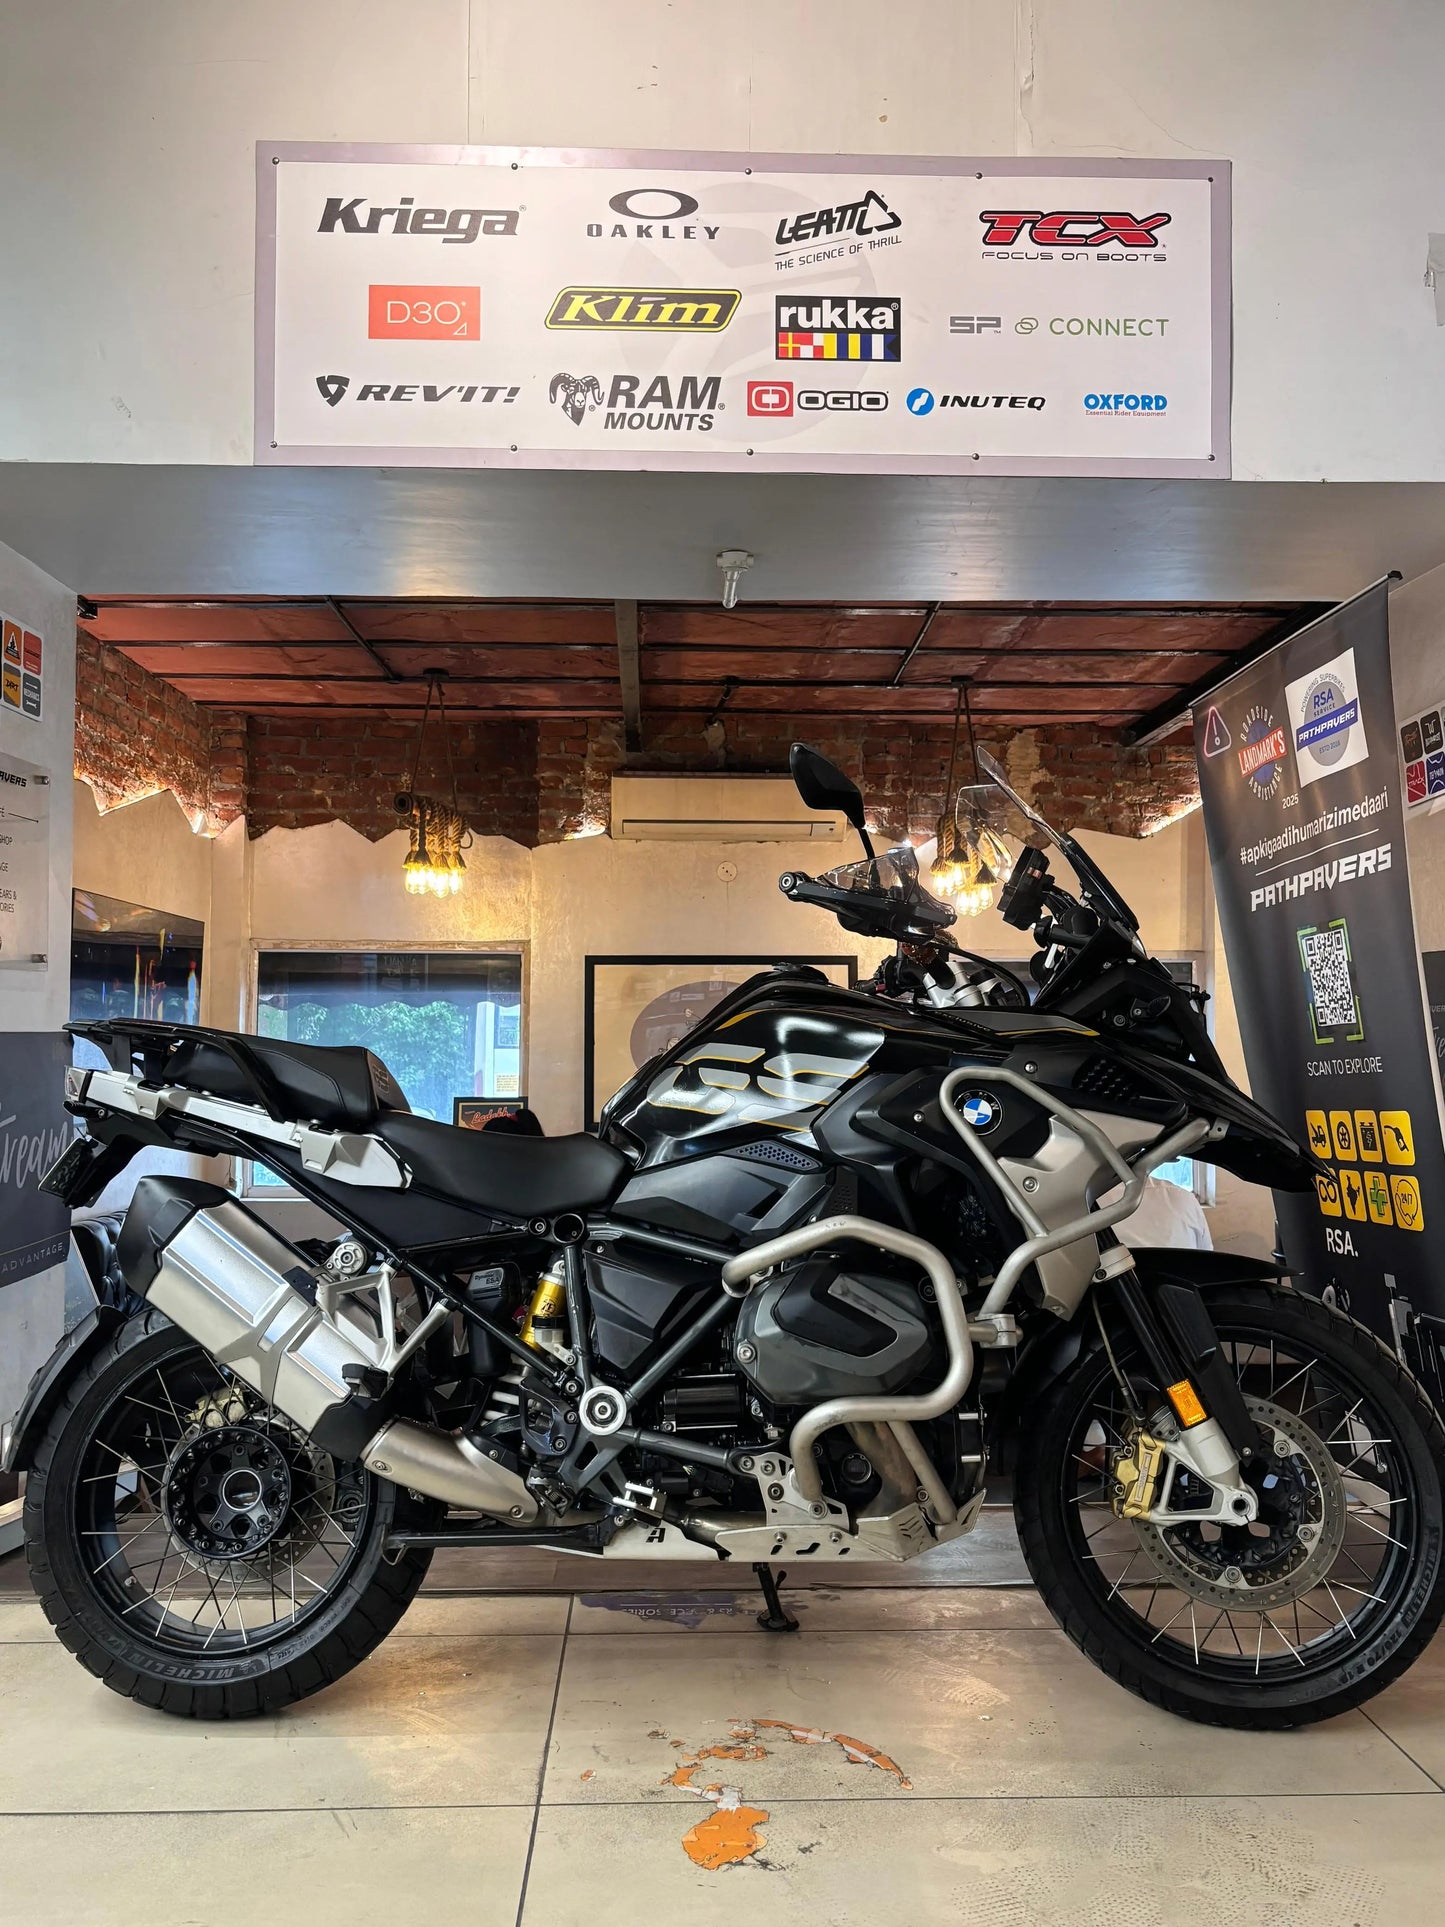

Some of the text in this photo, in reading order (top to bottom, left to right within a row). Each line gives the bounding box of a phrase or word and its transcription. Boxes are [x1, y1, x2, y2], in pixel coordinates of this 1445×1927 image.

[317, 198, 520, 244] Kriega
[587, 223, 720, 240] OAKLEY
[979, 210, 1172, 248] TCX
[775, 235, 902, 271] THE SCIENCE OF THRILL
[981, 251, 1054, 261] FOCUS
[1096, 253, 1168, 263] BOOTS
[779, 300, 896, 330] rukka
[949, 315, 1170, 338] SP CONNECT
[356, 384, 521, 404] REV'IT!
[607, 374, 722, 411] RAM
[797, 389, 889, 411] OGIO
[939, 394, 1047, 412] INUTEQ
[1084, 393, 1168, 410] OXFORD
[603, 411, 715, 432] MOUNTS
[1132, 410, 1167, 418] Equipment
[1301, 677, 1319, 713] POWERING
[1313, 688, 1334, 709] RSA
[1313, 702, 1336, 718] SERVICE
[1240, 705, 1274, 742] ROADSIDE
[1298, 707, 1356, 743] PATHPAVERS
[1237, 730, 1285, 775] LANDMARK'S
[1248, 763, 1283, 801] ASSISTANCE
[1282, 793, 1299, 809] 2025
[1240, 786, 1389, 865] #apkigaadihumarizimedaari
[1250, 843, 1392, 912] PATHPAVERS
[1307, 1056, 1383, 1076] SCAN TO EXPLORE
[1400, 1193, 1413, 1205] 24/7
[1326, 1227, 1359, 1257] RSA.
[1, 1241, 64, 1274] ADVANTAGE
[1403, 1547, 1438, 1624] MICHELIN
[127, 1650, 235, 1681] MICHELIN
